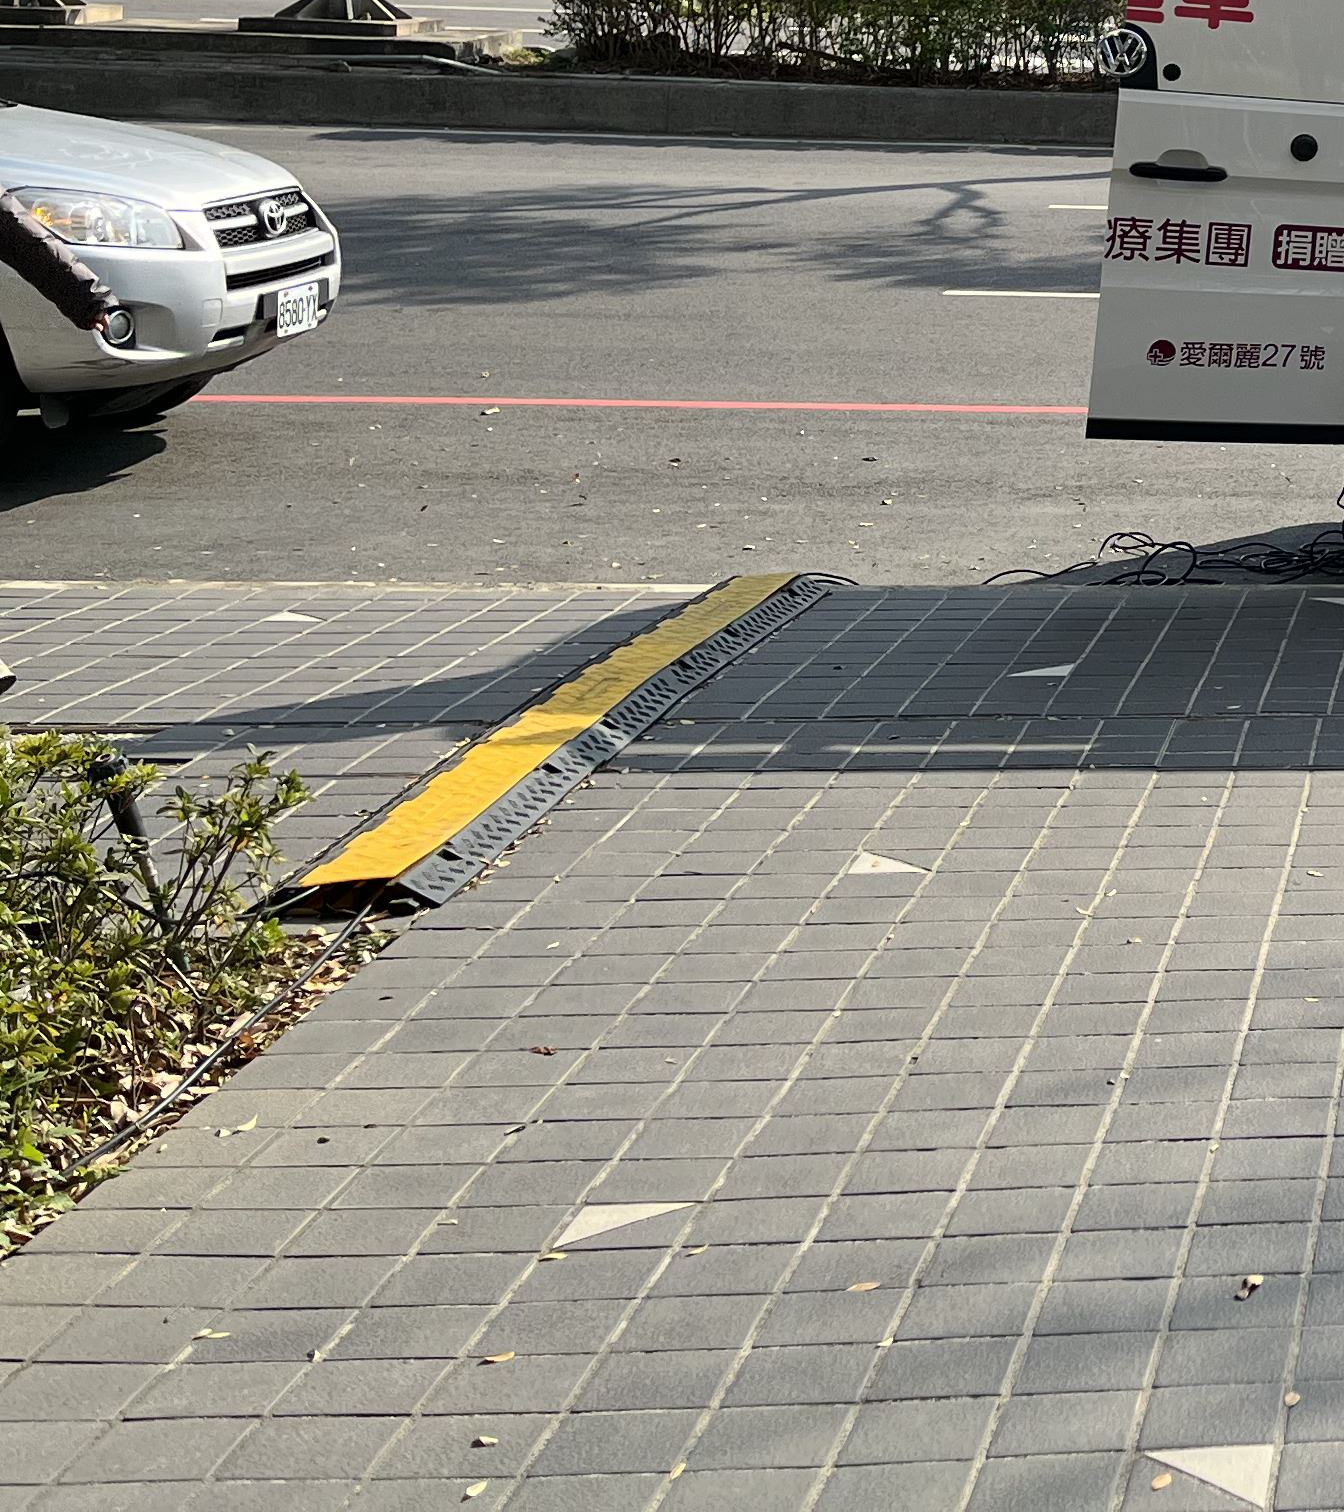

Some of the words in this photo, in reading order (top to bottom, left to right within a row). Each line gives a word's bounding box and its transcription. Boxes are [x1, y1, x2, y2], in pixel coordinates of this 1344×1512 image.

[1104, 216, 1252, 268] 療集團
[1179, 340, 1326, 370] 愛爾麗27號
